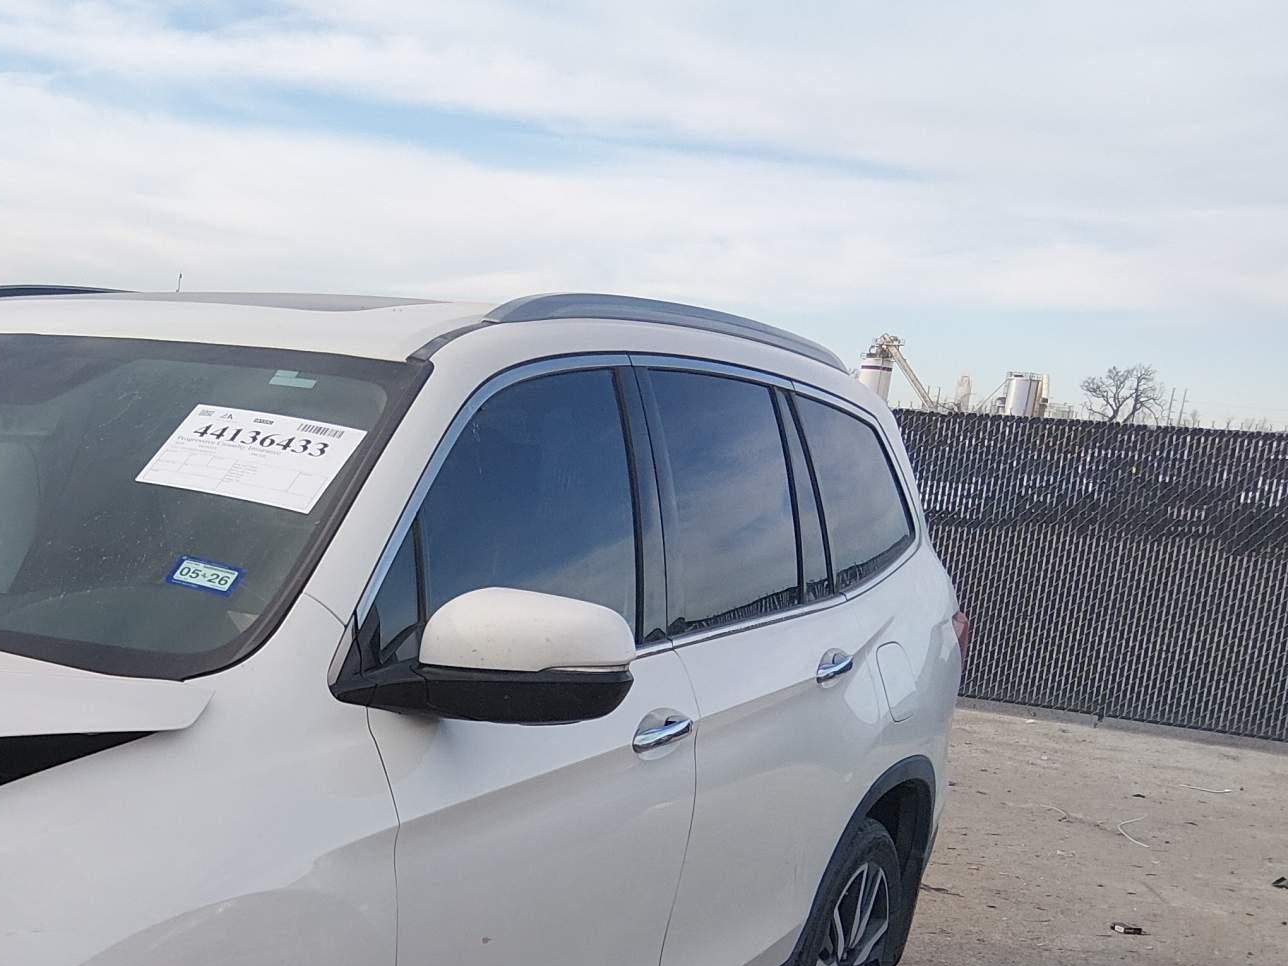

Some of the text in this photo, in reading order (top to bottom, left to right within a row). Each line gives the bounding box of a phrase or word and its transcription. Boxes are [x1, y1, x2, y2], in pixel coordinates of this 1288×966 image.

[193, 423, 329, 458] 44136433
[179, 566, 202, 579] 05
[206, 572, 231, 586] 26
